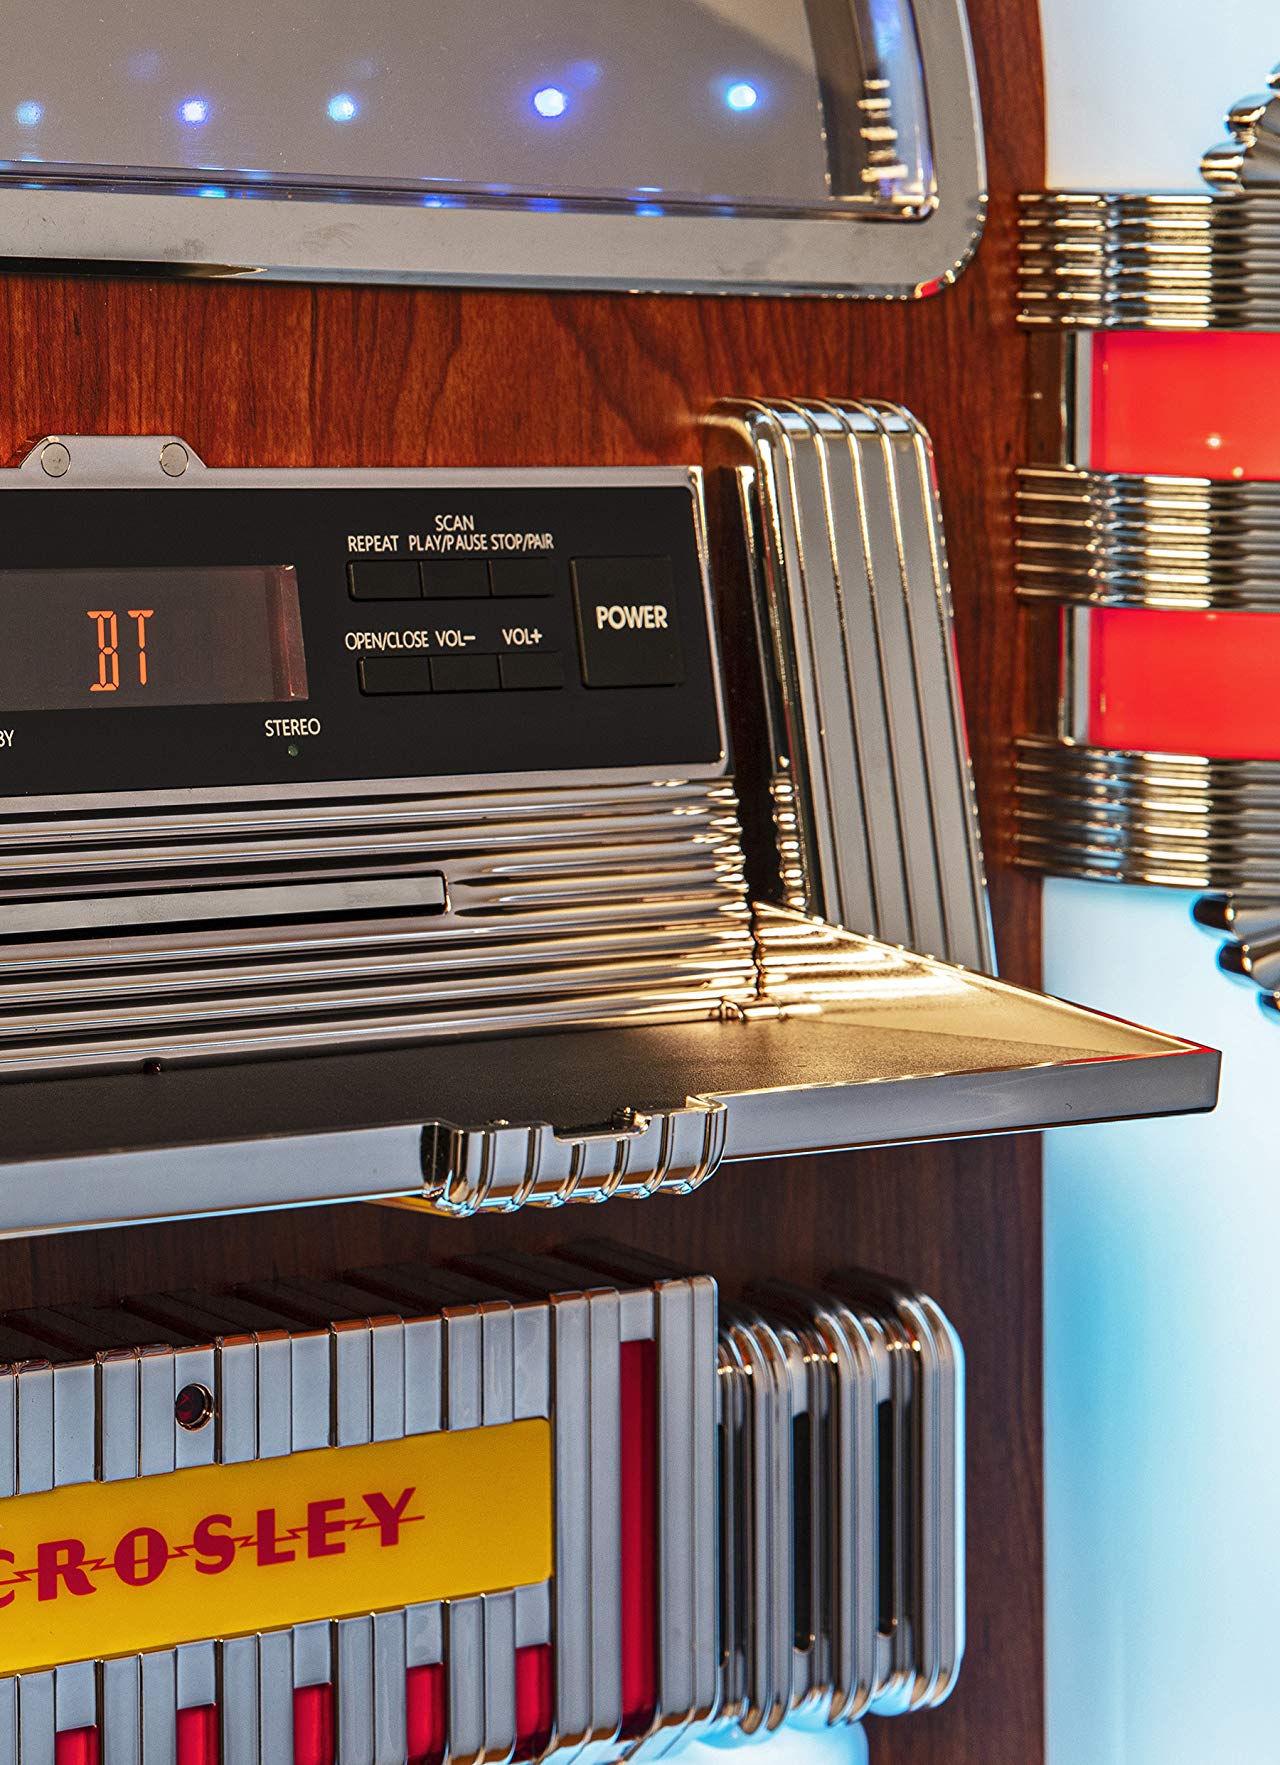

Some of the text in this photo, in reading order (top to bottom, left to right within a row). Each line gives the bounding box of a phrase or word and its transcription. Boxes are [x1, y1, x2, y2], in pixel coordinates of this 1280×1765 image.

[435, 514, 475, 532] SCAN
[348, 532, 555, 553] REPEAT PLAY/PAUSE STOP/PAIR
[595, 604, 669, 630] POWER
[345, 630, 430, 651] OPEN/CLOSE
[501, 627, 543, 646] VOL+
[86, 609, 155, 692] BT
[264, 717, 321, 737] STEREO
